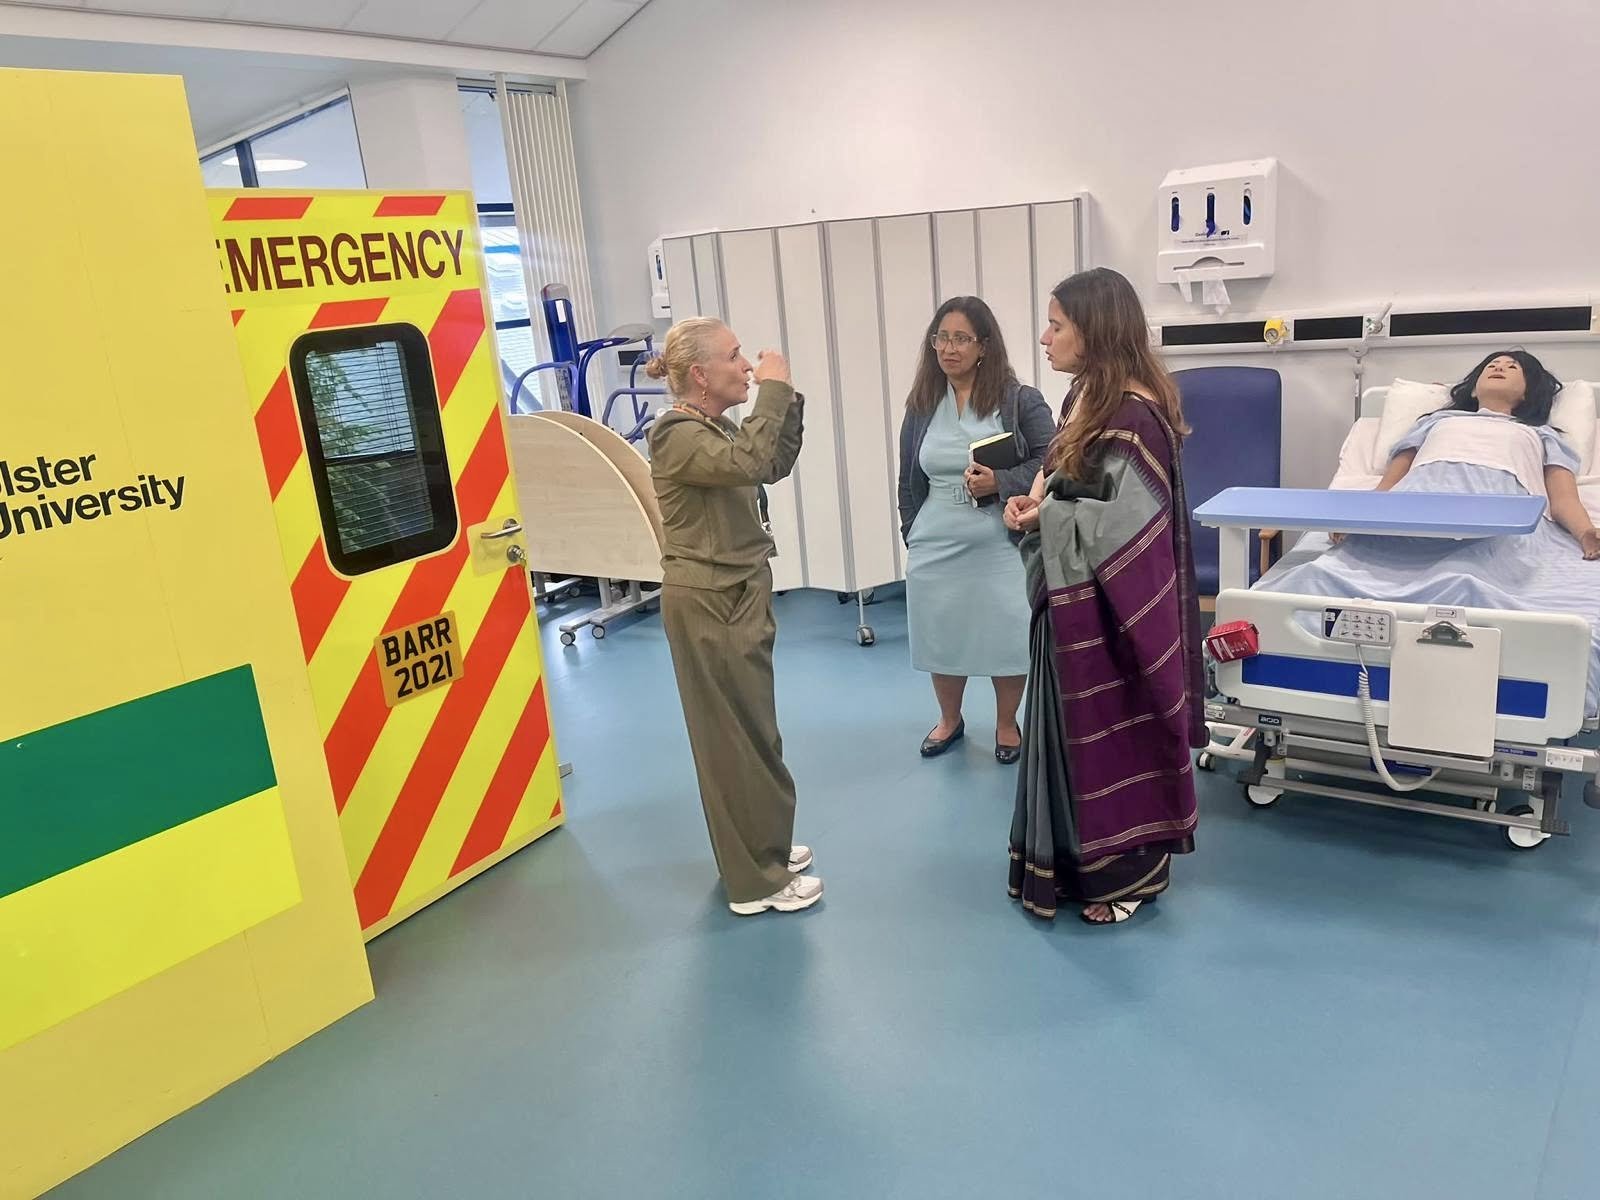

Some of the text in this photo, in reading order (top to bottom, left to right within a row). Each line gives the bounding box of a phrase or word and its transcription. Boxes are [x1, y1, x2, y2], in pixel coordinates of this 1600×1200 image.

[216, 229, 464, 294] MERGENCY
[0, 454, 97, 497] lster
[382, 617, 452, 667] BARR
[394, 650, 453, 698] 2021
